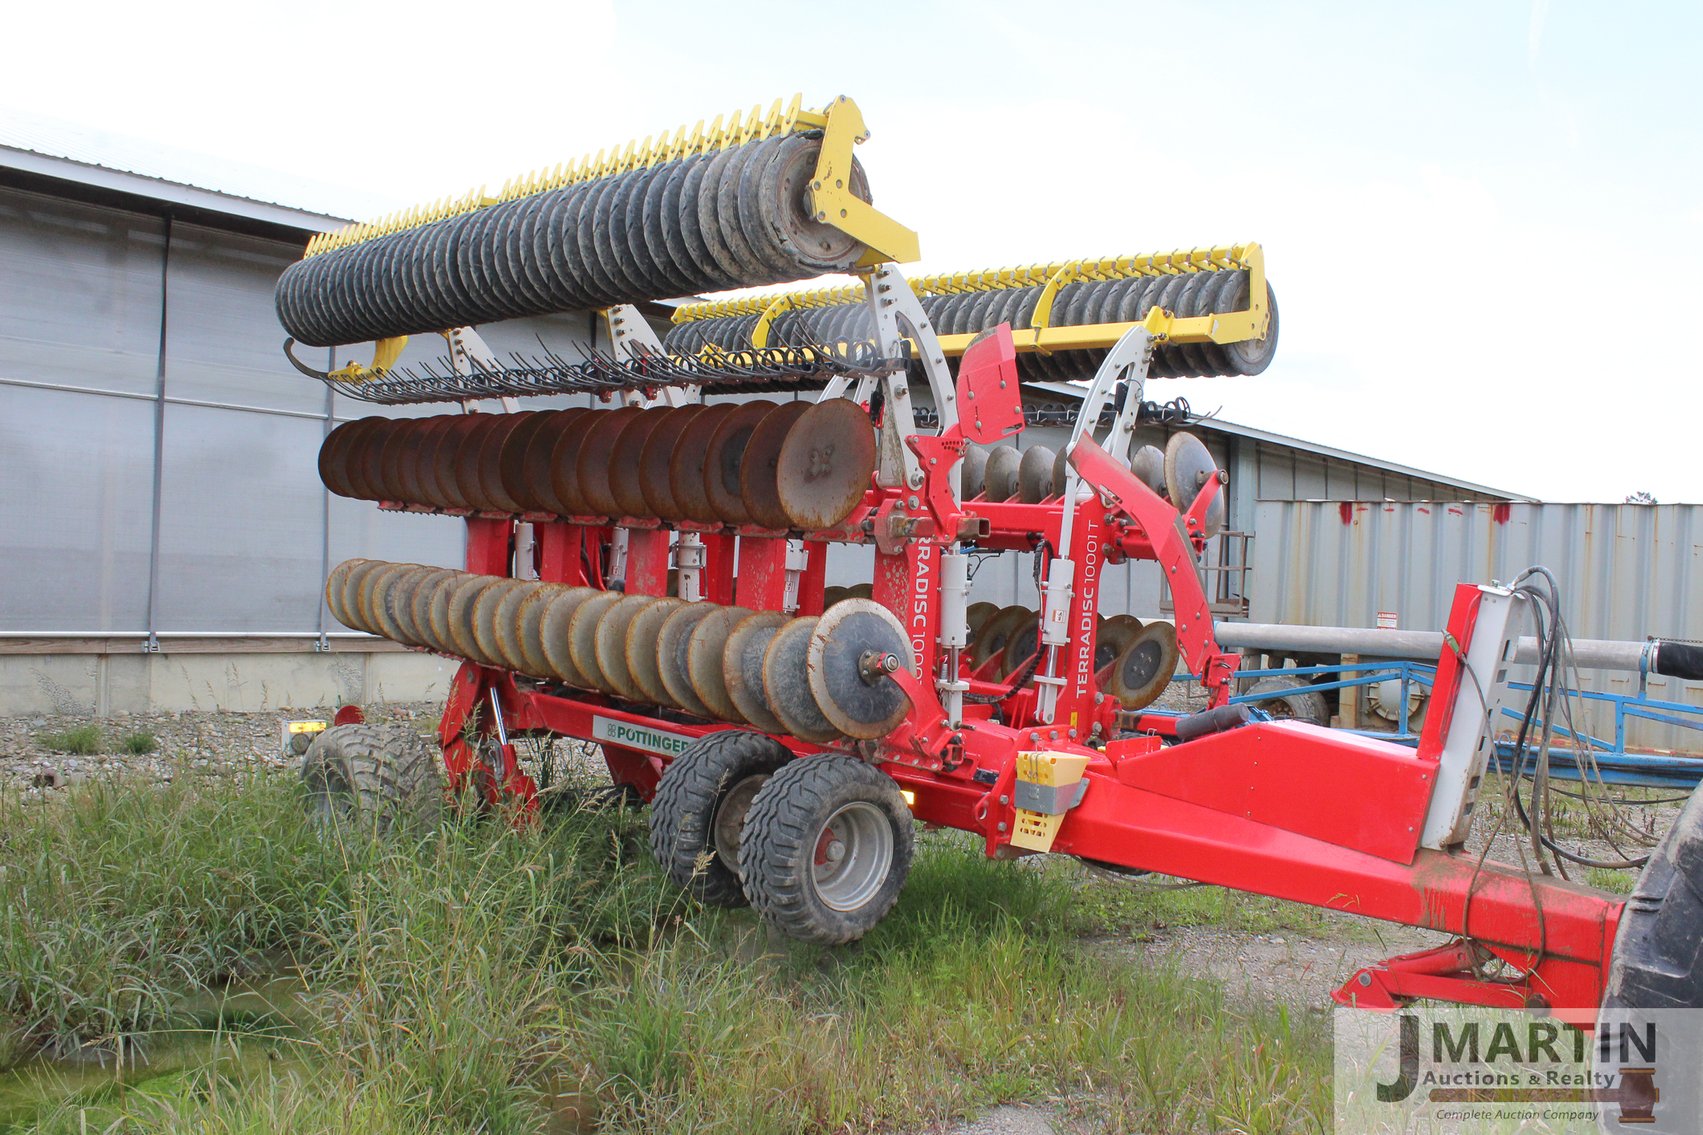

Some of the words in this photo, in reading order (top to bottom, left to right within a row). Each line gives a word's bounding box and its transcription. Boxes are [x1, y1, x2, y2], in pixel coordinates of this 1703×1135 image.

[1087, 519, 1099, 532] T
[1084, 534, 1098, 584] 10001
[1076, 587, 1095, 699] TERRADISC
